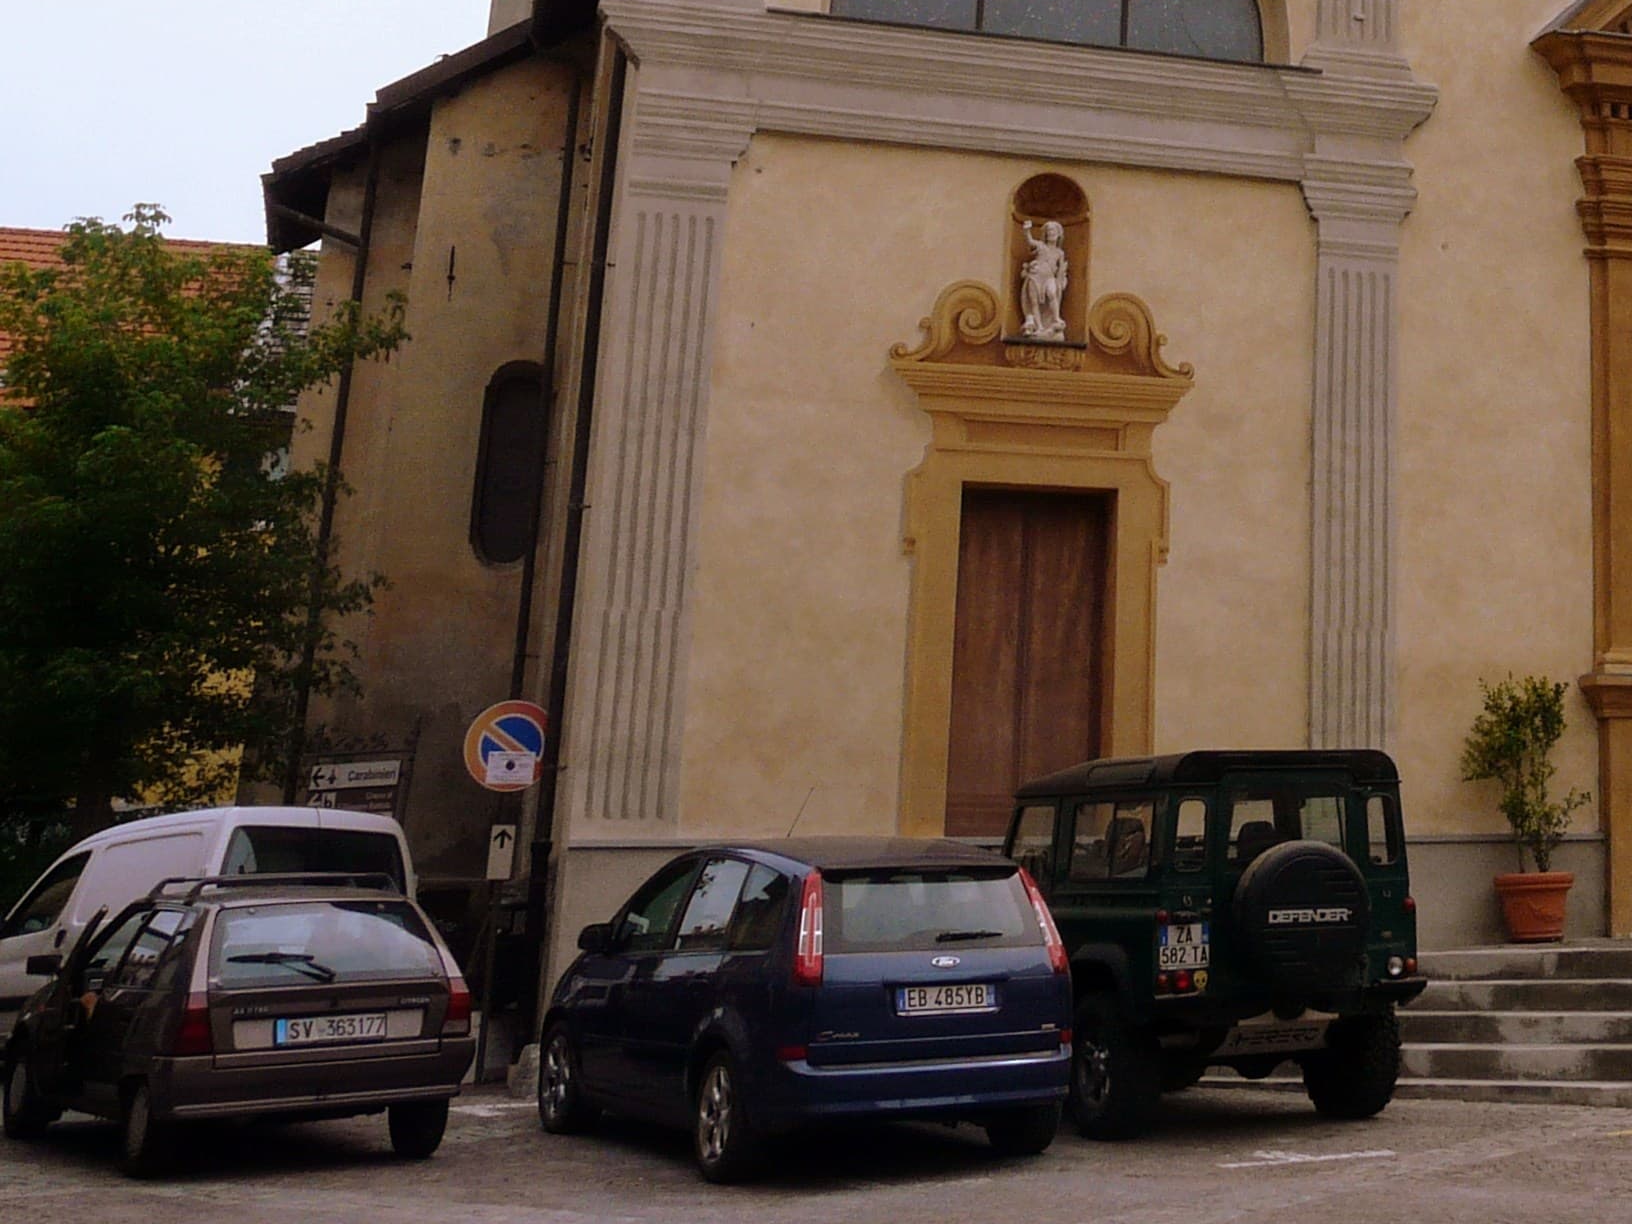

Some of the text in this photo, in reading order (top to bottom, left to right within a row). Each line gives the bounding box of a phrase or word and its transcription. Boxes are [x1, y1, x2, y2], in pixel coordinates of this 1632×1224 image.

[1268, 908, 1349, 924] DEFENDER
[1176, 927, 1193, 944] ZA
[1162, 946, 1208, 964] 582 TA
[907, 986, 985, 1008] EB 485YB
[289, 1016, 386, 1040] SV 363177
